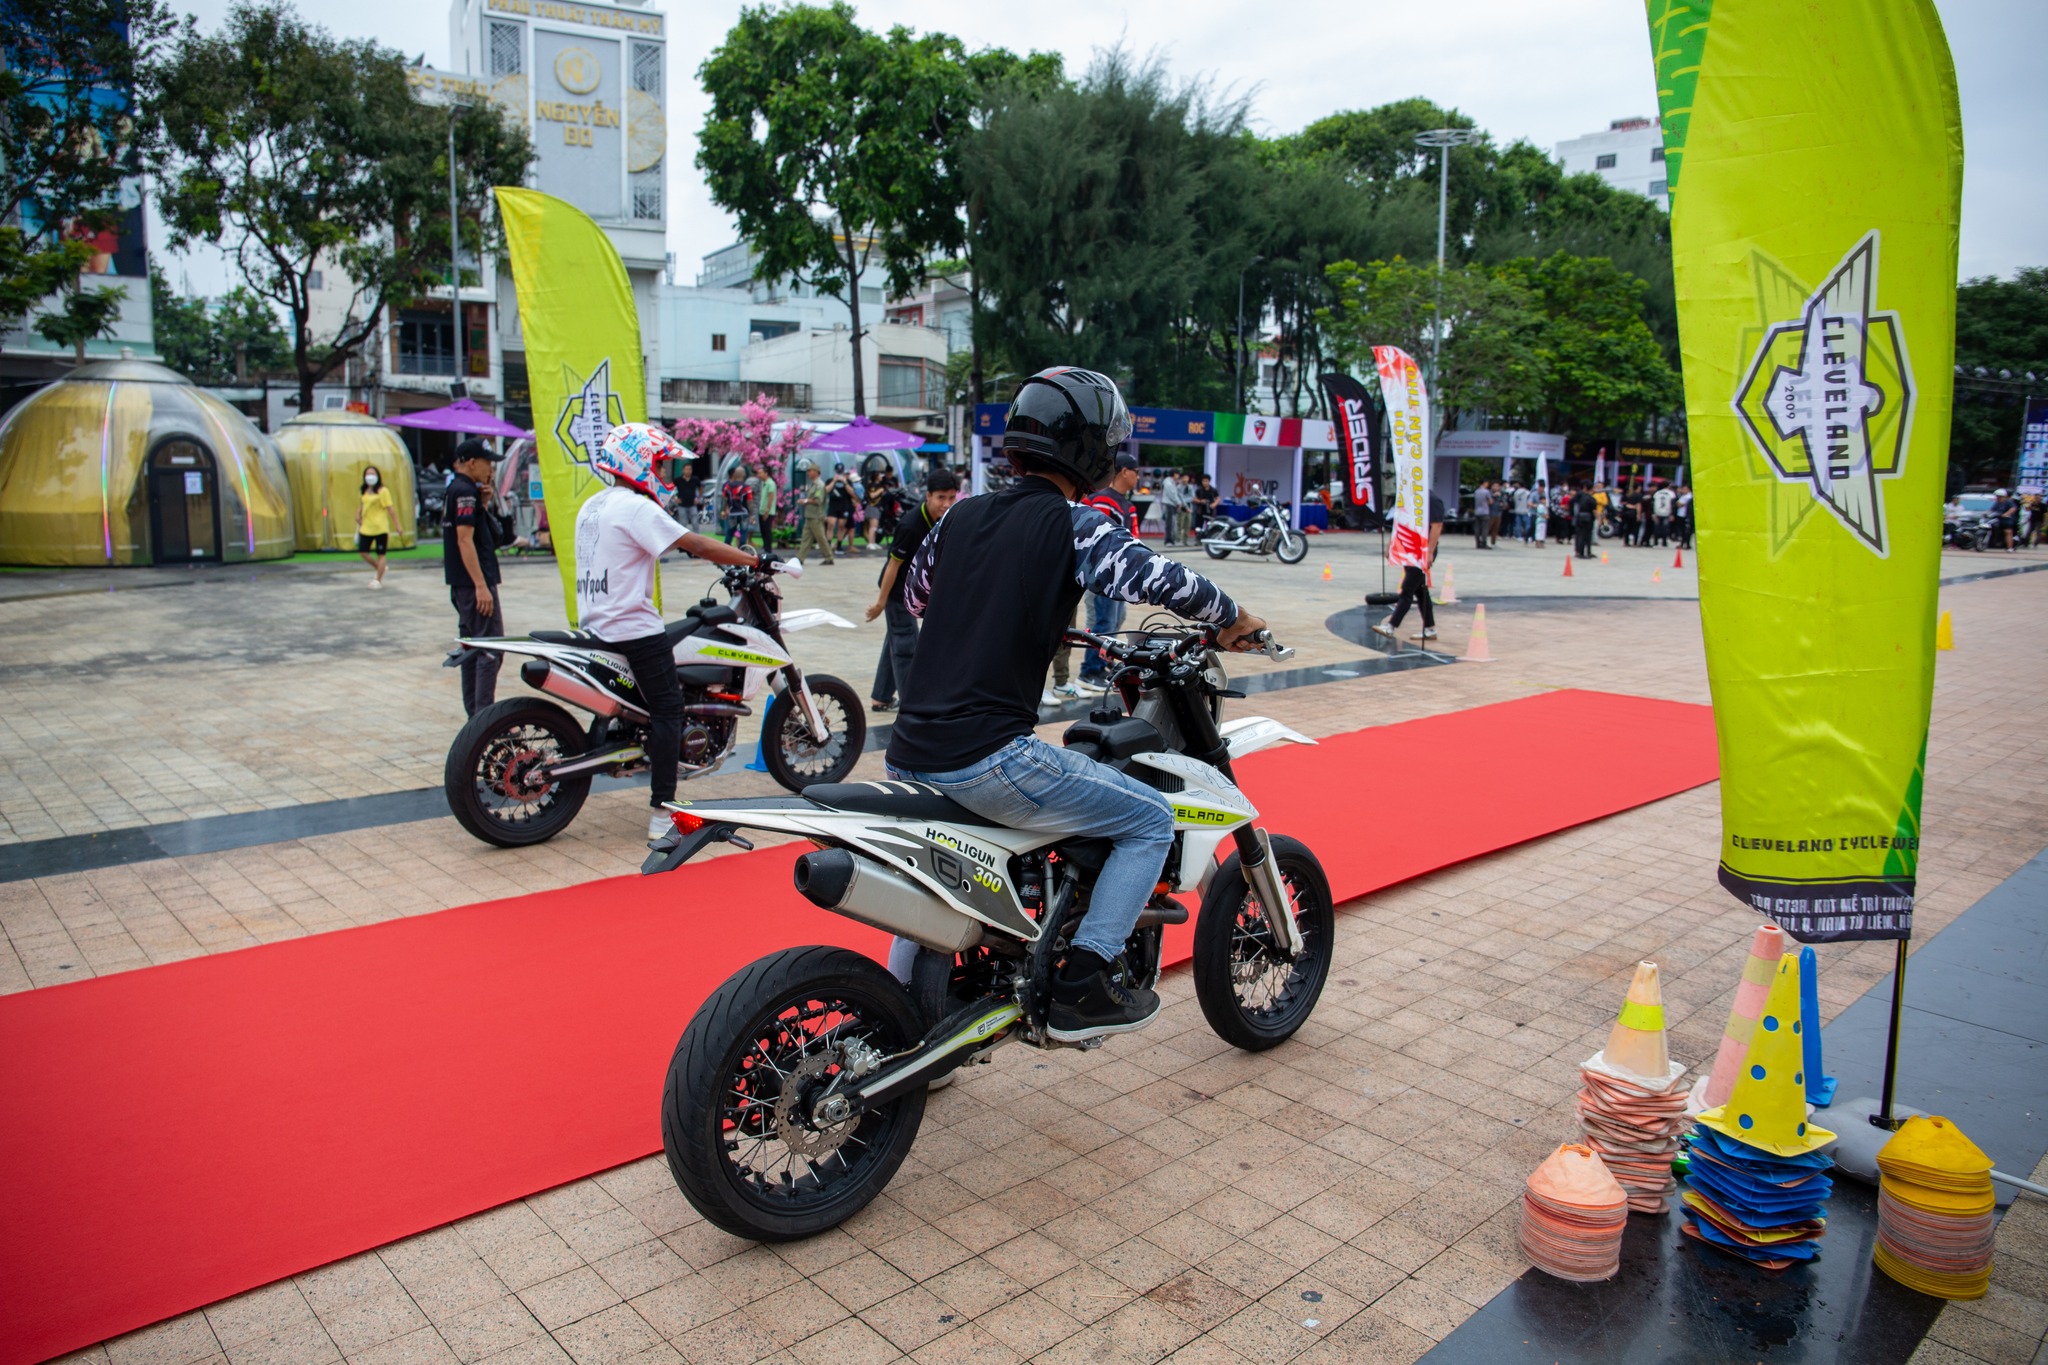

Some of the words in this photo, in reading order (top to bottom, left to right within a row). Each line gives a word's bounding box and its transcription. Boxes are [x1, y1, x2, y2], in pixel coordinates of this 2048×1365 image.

[1784, 385, 1796, 420] 2009
[1821, 316, 1850, 480] CLEVELAND
[1344, 398, 1376, 513] SRIDER
[1412, 465, 1424, 527] MOTO
[589, 652, 630, 675] HOOLIGUN
[718, 649, 774, 664] CLEVELAND
[616, 674, 635, 690] 300
[925, 827, 996, 868] HOOLIGUN
[1732, 834, 1834, 853] CLEVELAND
[972, 866, 1003, 893] 300
